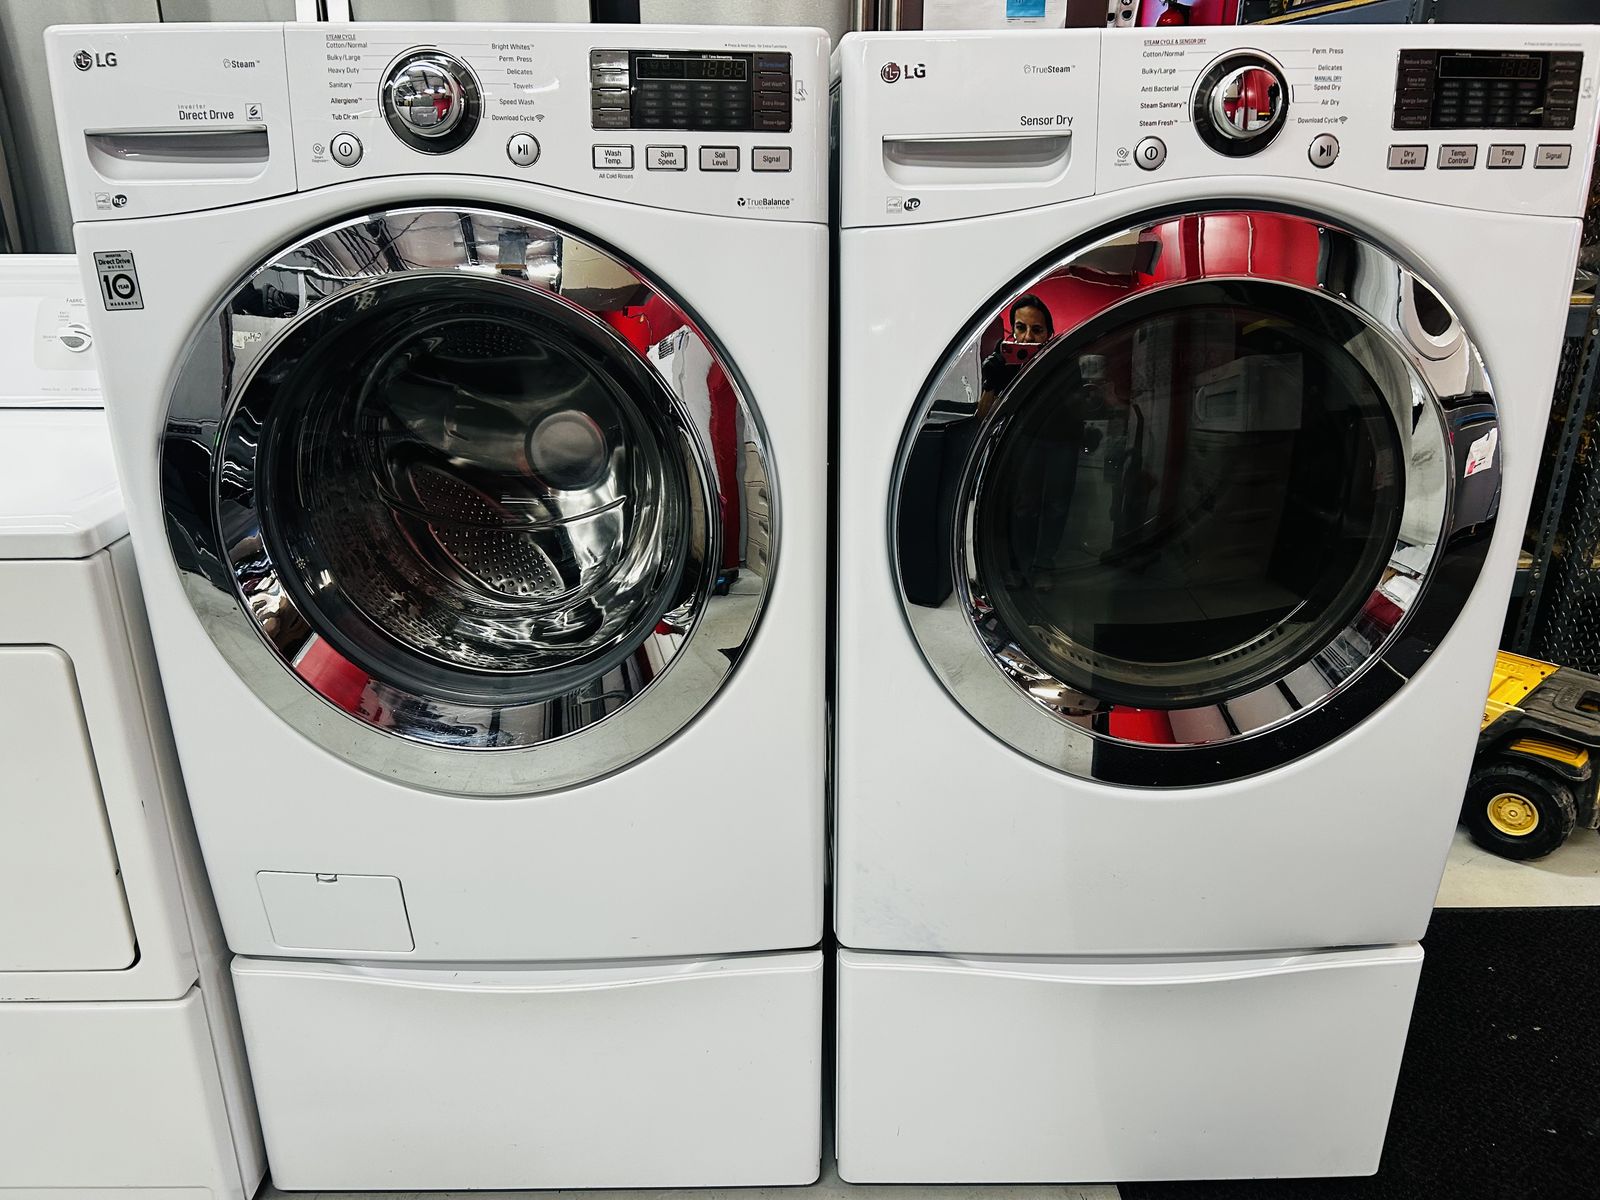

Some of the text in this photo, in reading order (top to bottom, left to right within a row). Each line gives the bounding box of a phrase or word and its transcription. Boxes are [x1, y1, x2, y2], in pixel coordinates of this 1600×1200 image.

[491, 43, 509, 51] Bright
[1142, 50, 1185, 58] Cotton/Normal
[95, 52, 117, 67] LG
[904, 64, 926, 79] LG
[499, 98, 517, 106] Speed
[179, 109, 234, 120] Direct Drive
[520, 114, 535, 122] Cycle
[1020, 114, 1074, 127] Sensor Dry
[660, 150, 674, 158] Spin
[1403, 150, 1415, 158] Dry
[1545, 152, 1563, 160] Signal
[605, 157, 622, 165] Temp.
[658, 158, 677, 166] Speed
[762, 155, 780, 163] Signal
[1501, 156, 1512, 164] Dry
[103, 273, 135, 300] 10
